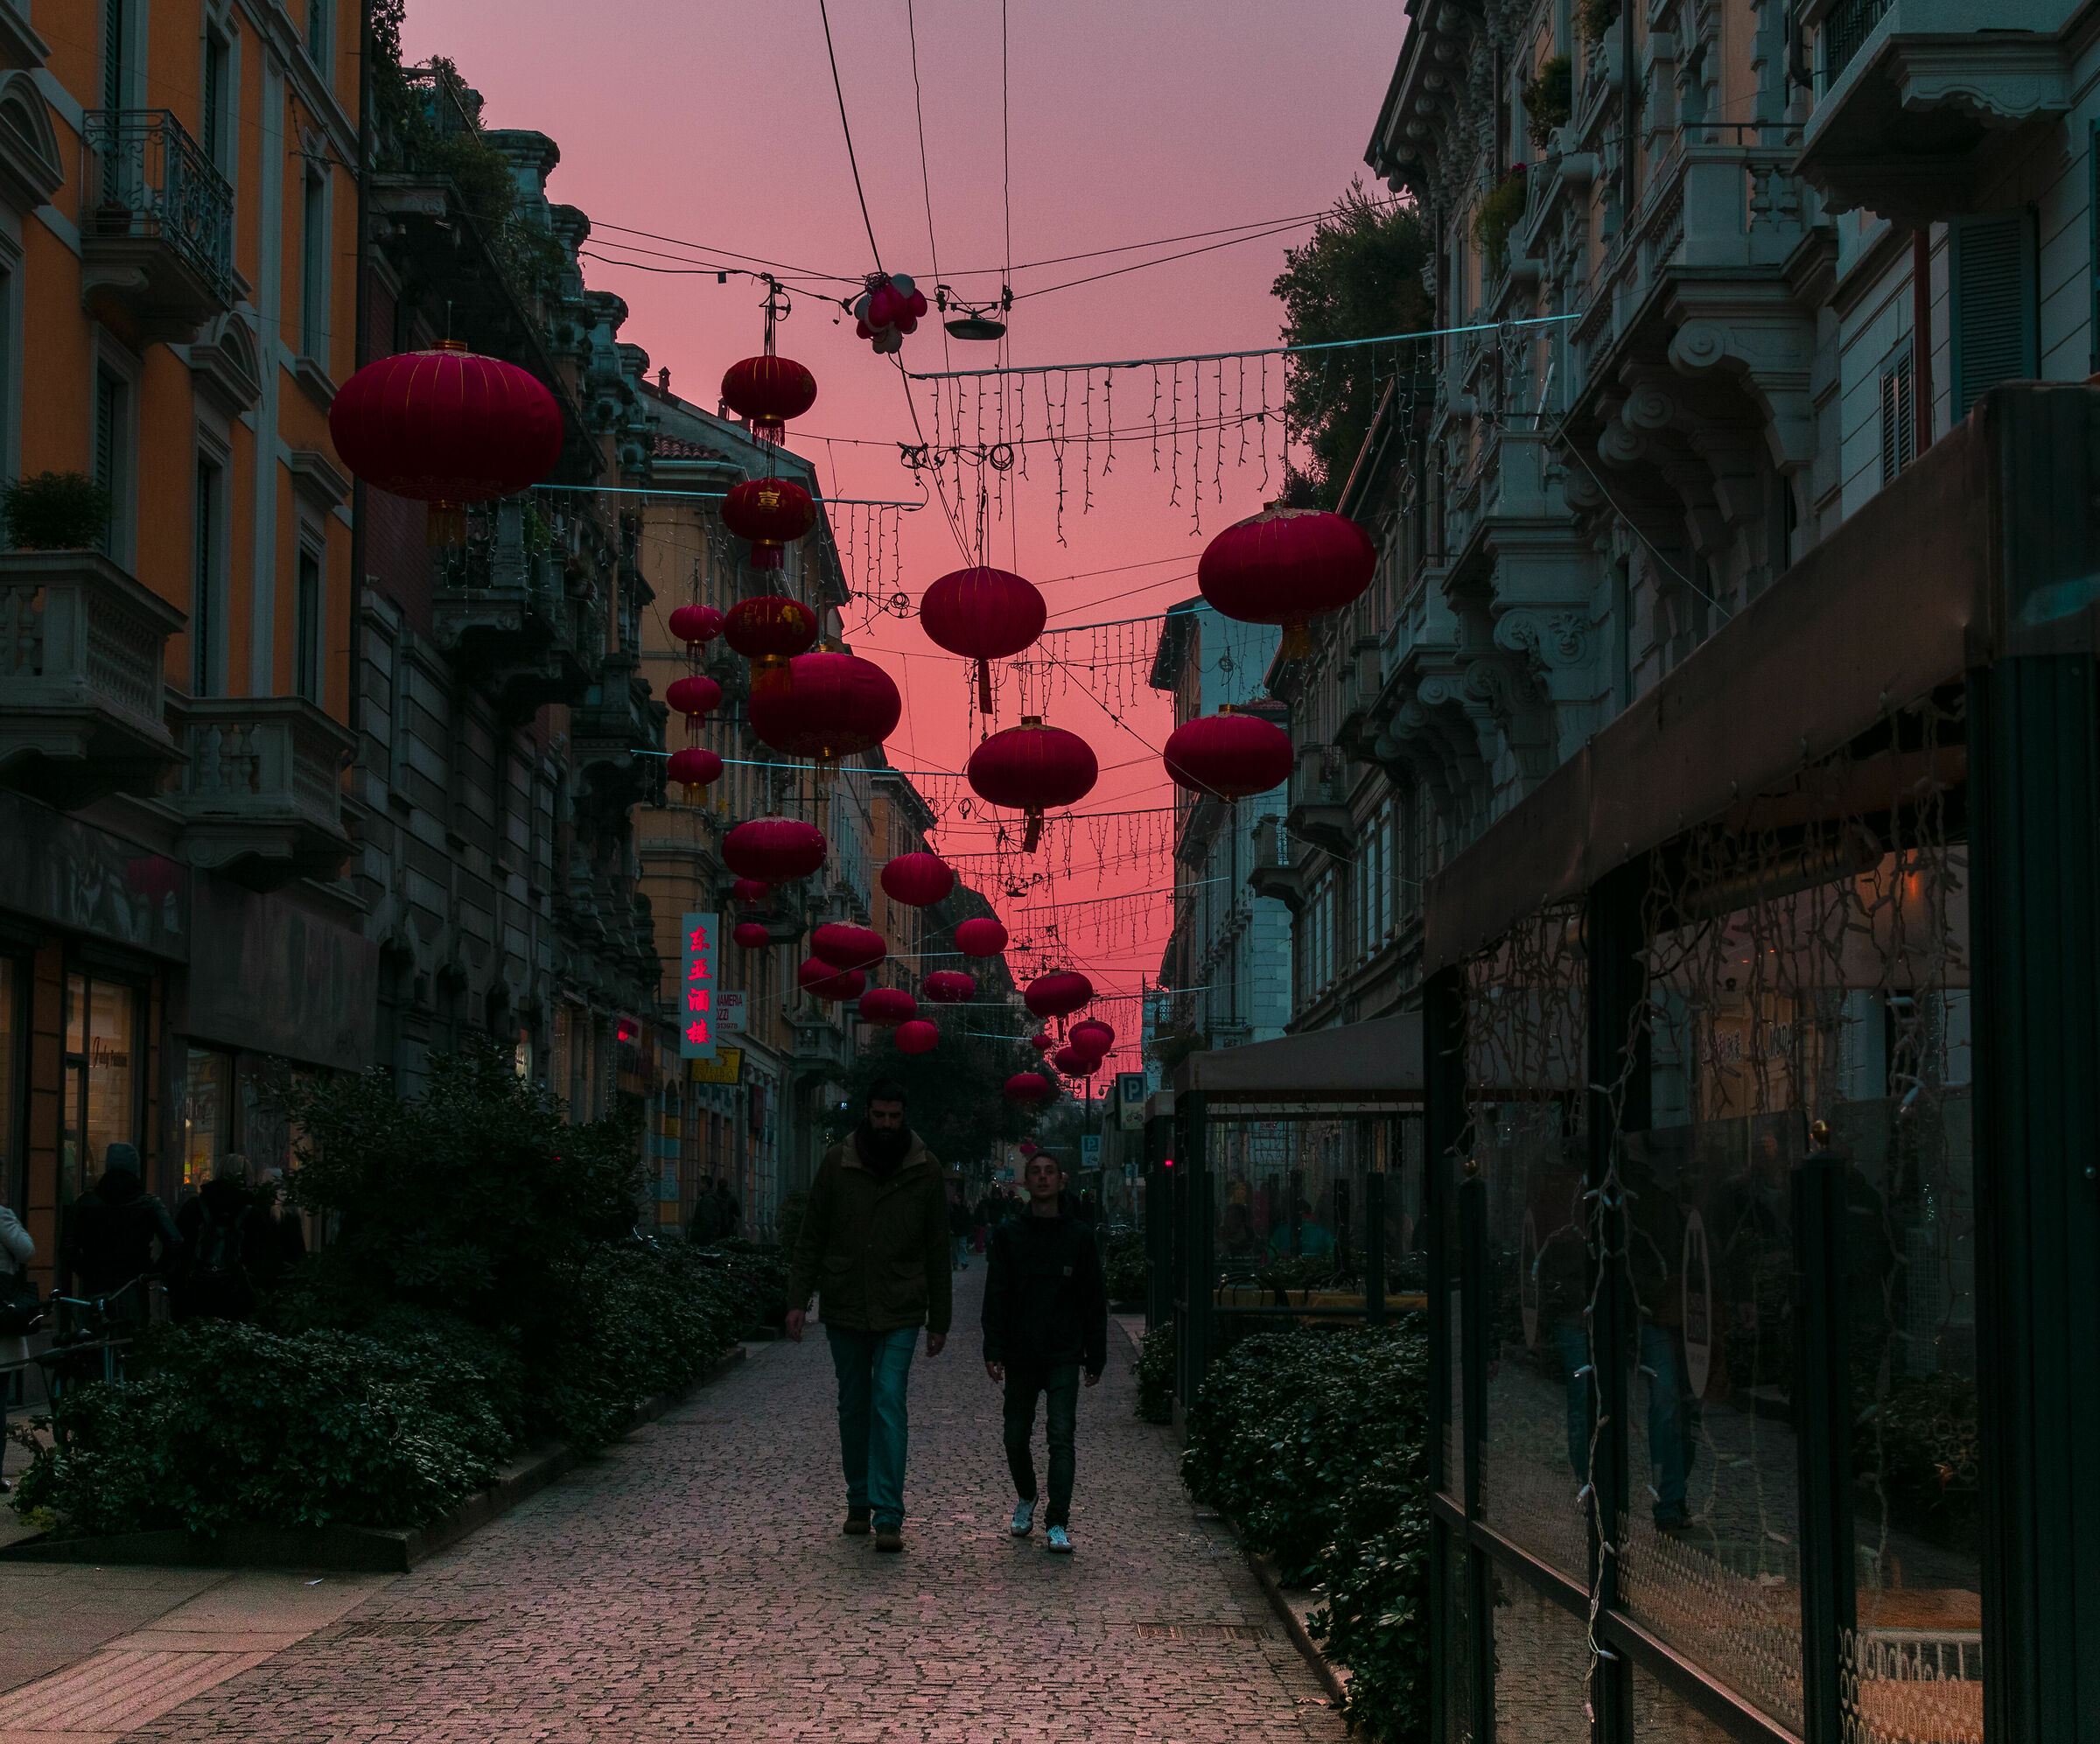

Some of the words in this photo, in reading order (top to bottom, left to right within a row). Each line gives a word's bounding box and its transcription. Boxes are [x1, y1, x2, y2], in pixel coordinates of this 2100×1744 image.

[685, 925, 712, 1045] 东亚酒楼
[1128, 1080, 1140, 1100] P
